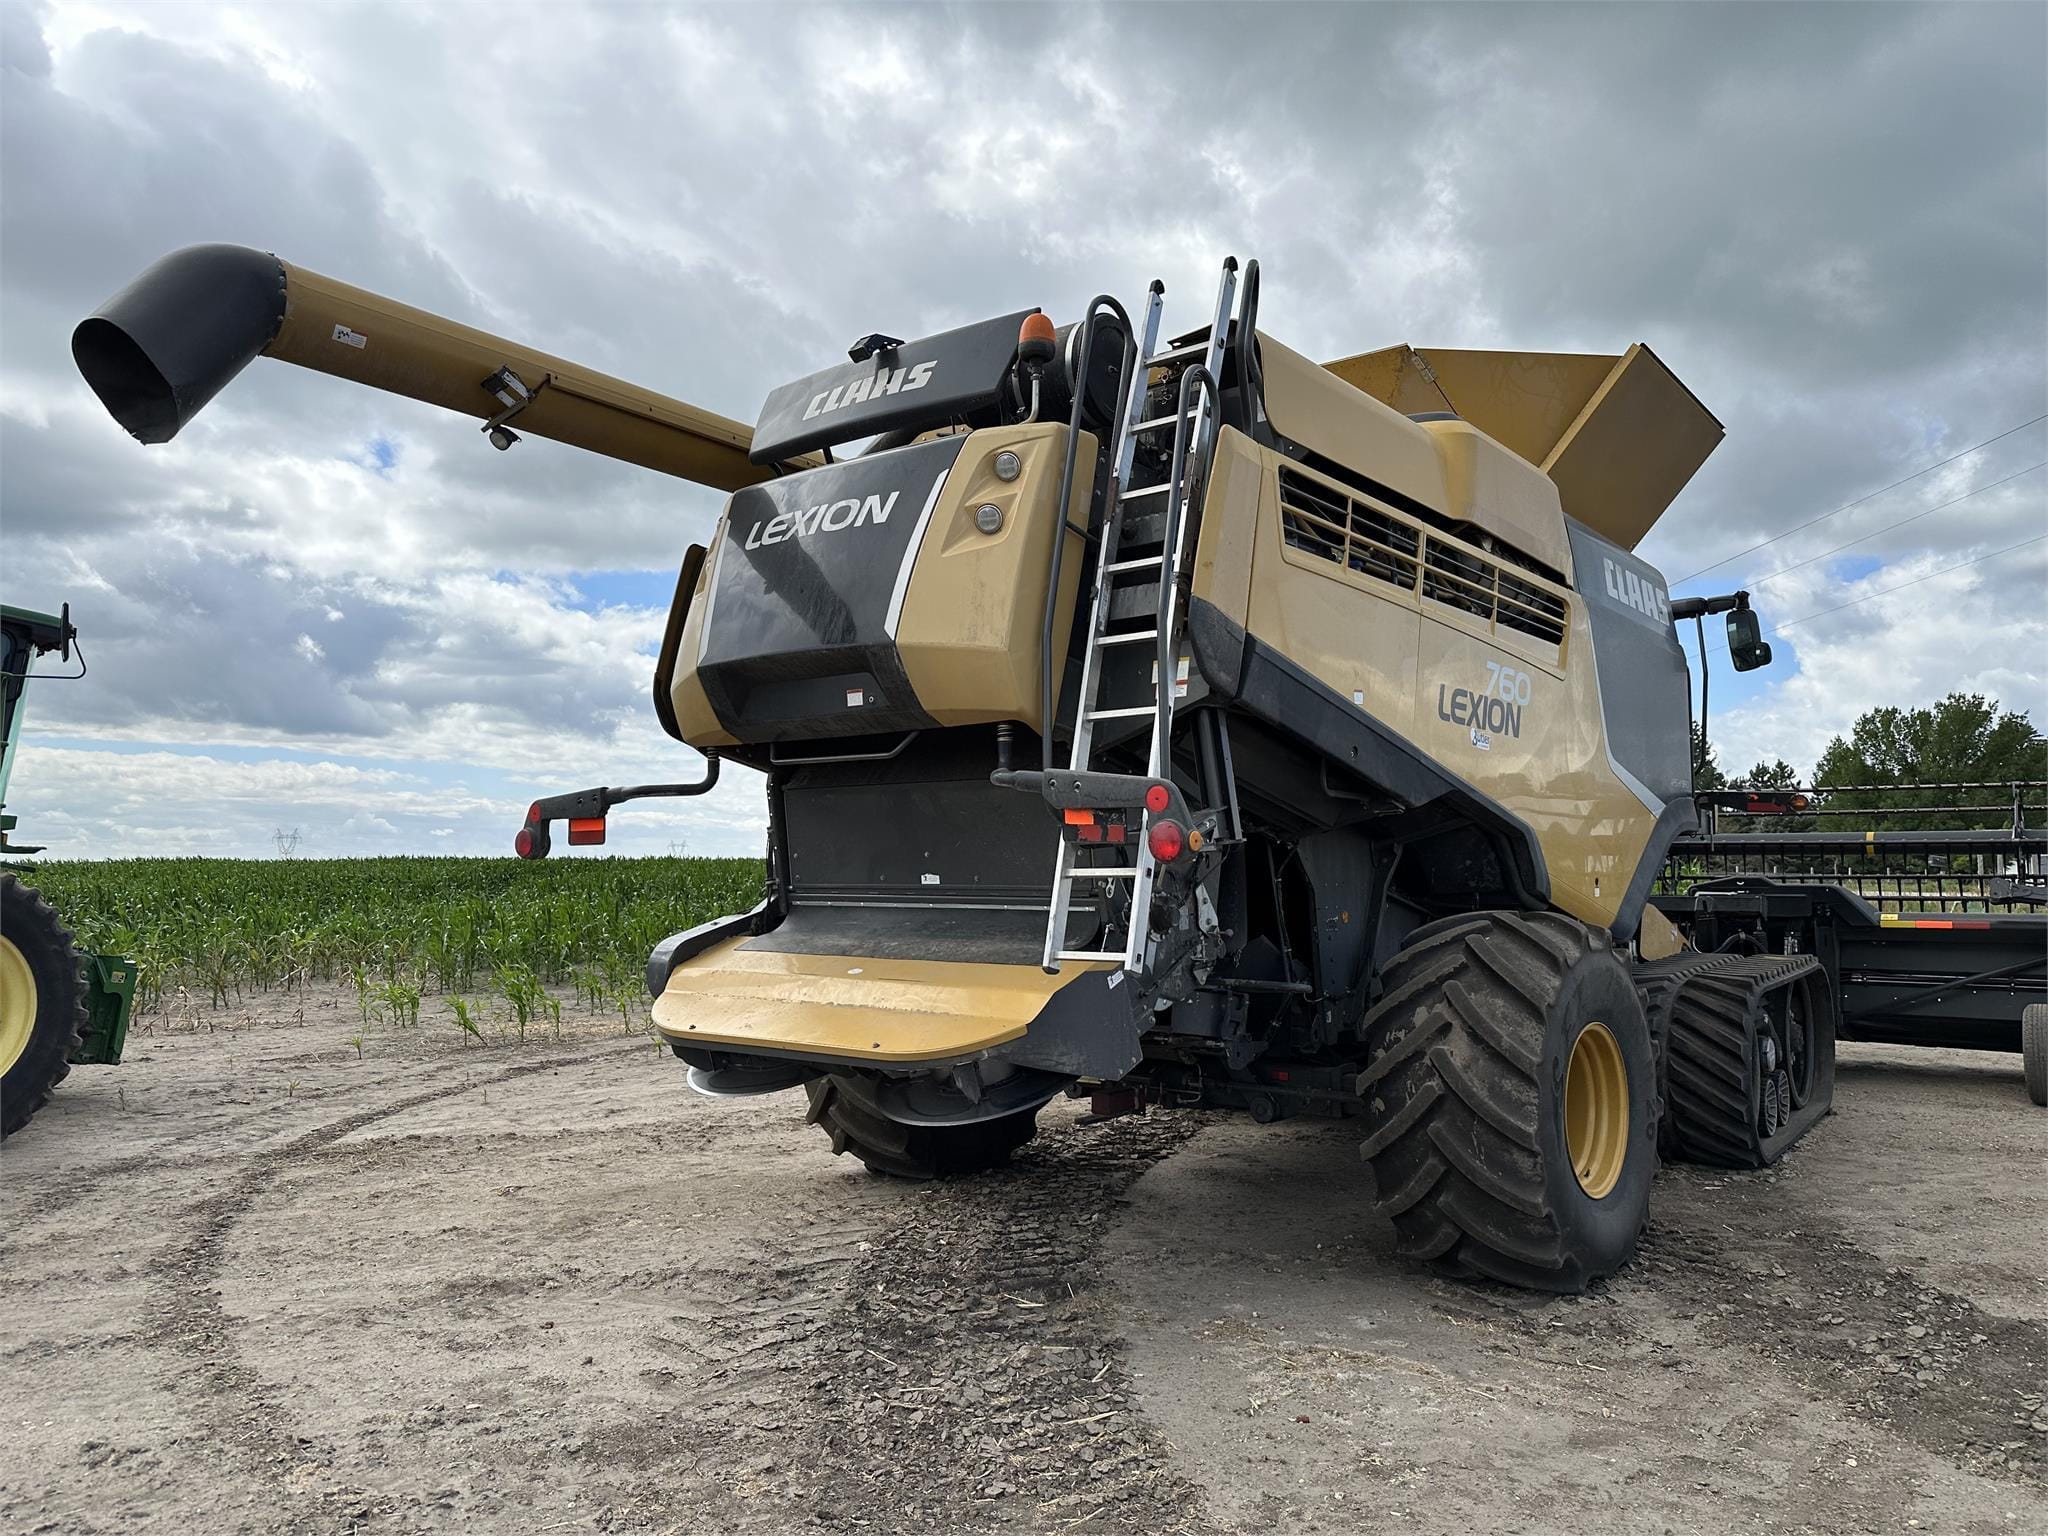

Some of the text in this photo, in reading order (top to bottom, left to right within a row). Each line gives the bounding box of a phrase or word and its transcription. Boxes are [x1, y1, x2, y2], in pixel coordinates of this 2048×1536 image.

[802, 360, 938, 421] CLAAS
[745, 491, 900, 551] LEXION
[1603, 557, 1670, 627] CLAAS
[1438, 683, 1522, 739] LEXION
[1487, 660, 1531, 706] 760
